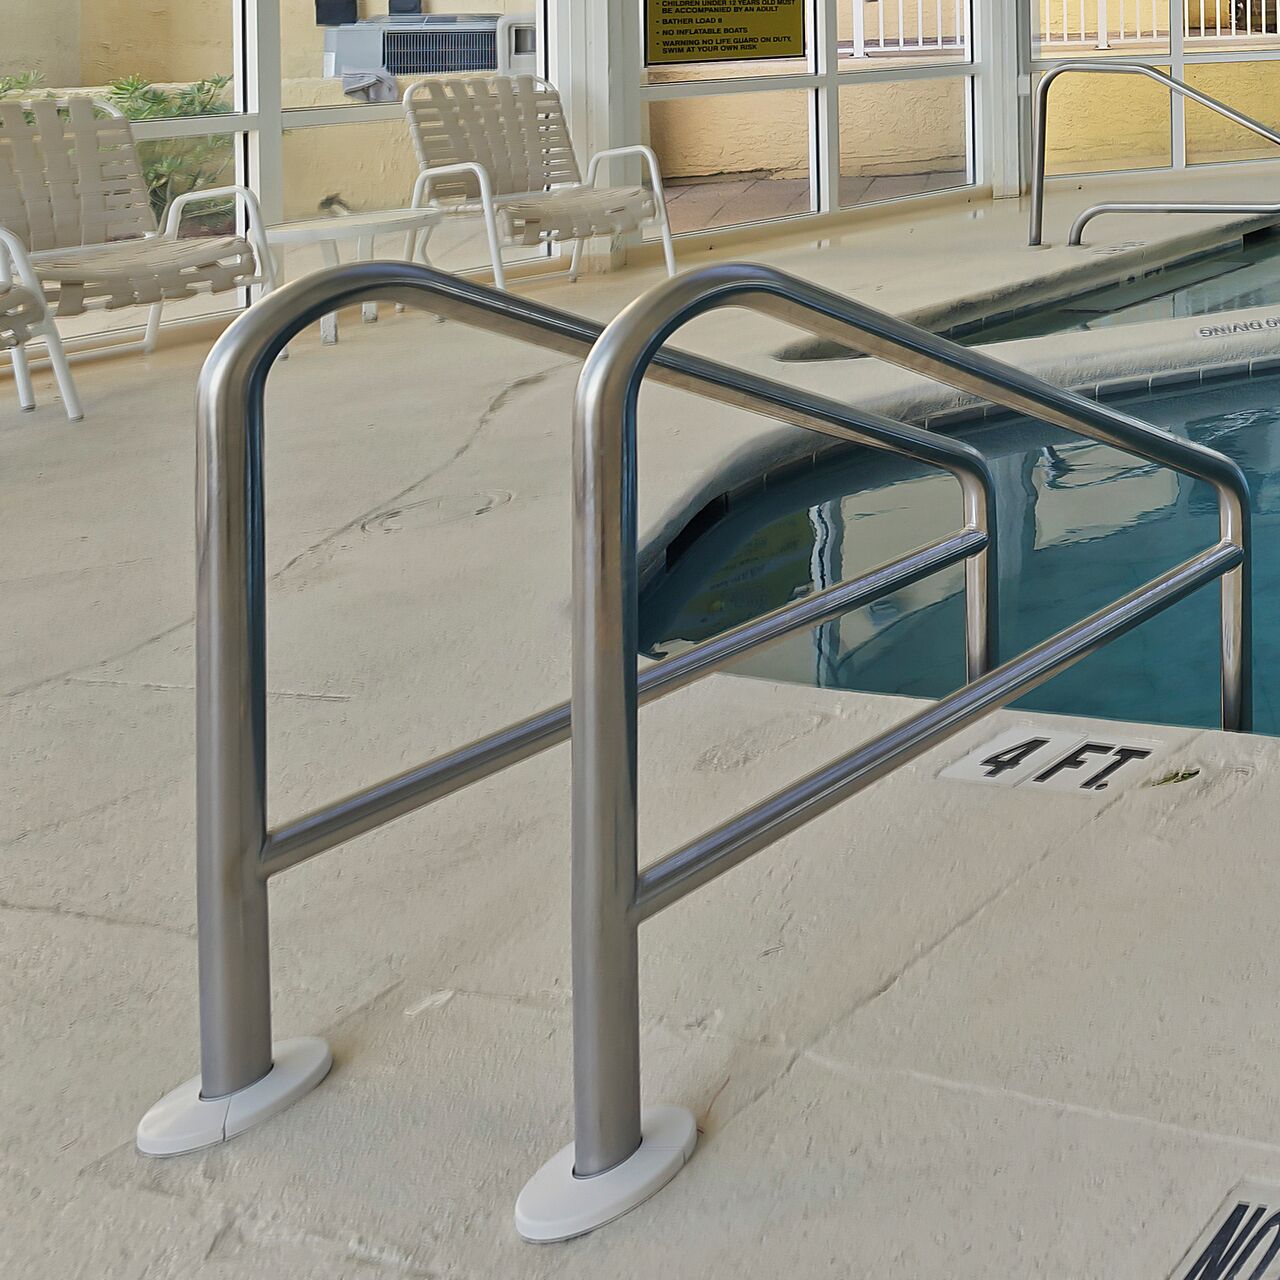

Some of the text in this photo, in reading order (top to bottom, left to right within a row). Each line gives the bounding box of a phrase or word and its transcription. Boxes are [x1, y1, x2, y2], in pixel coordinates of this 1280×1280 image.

[675, 6, 731, 14] ACCOMPANIED
[677, 28, 721, 36] INFLATABLE
[663, 39, 700, 47] WARNING
[1200, 320, 1263, 337] DIVING
[978, 737, 1154, 790] 4 FT.
